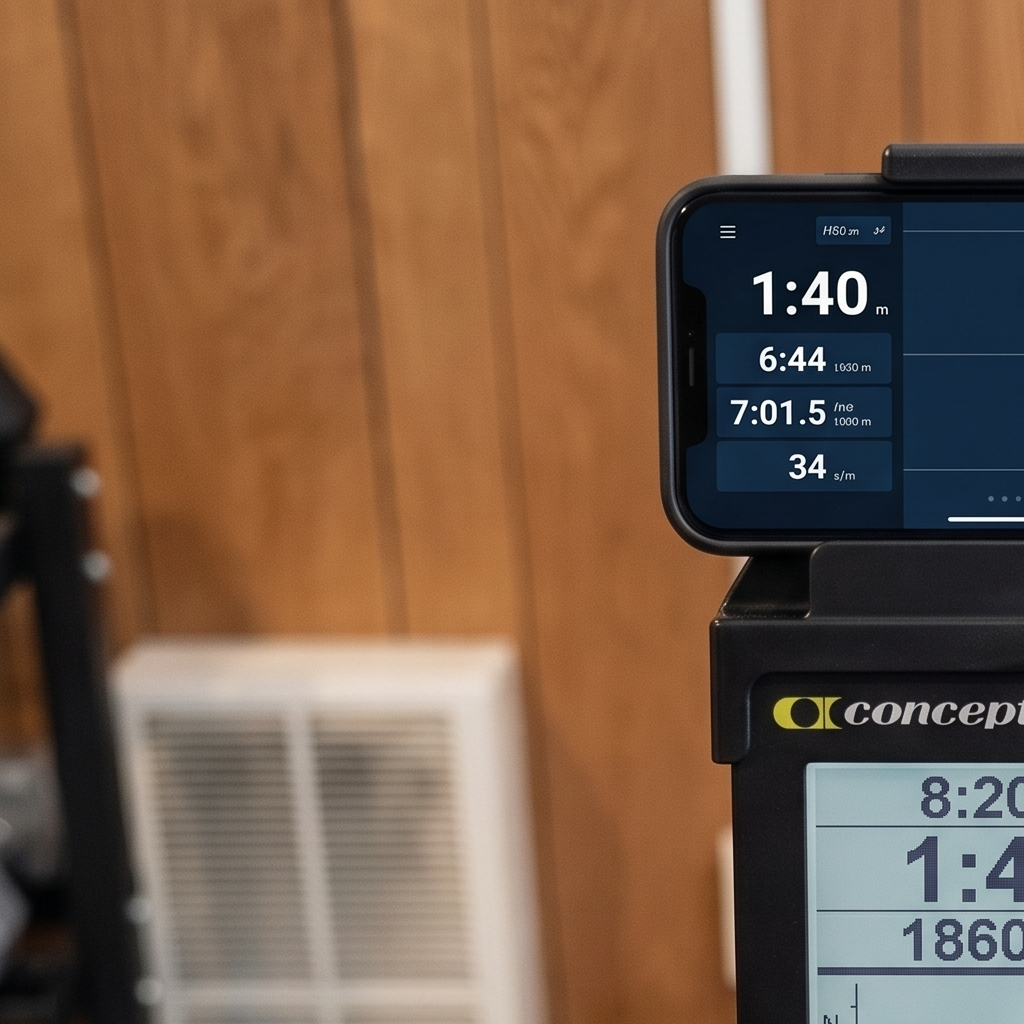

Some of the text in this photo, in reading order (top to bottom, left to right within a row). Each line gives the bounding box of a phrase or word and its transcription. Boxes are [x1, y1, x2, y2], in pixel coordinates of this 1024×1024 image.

[753, 270, 889, 315] 1:40 m
[759, 346, 827, 372] 6:44
[861, 364, 872, 372] m
[730, 399, 826, 426] 7:01.5
[861, 418, 872, 426] m
[788, 453, 856, 481] 34 s/m
